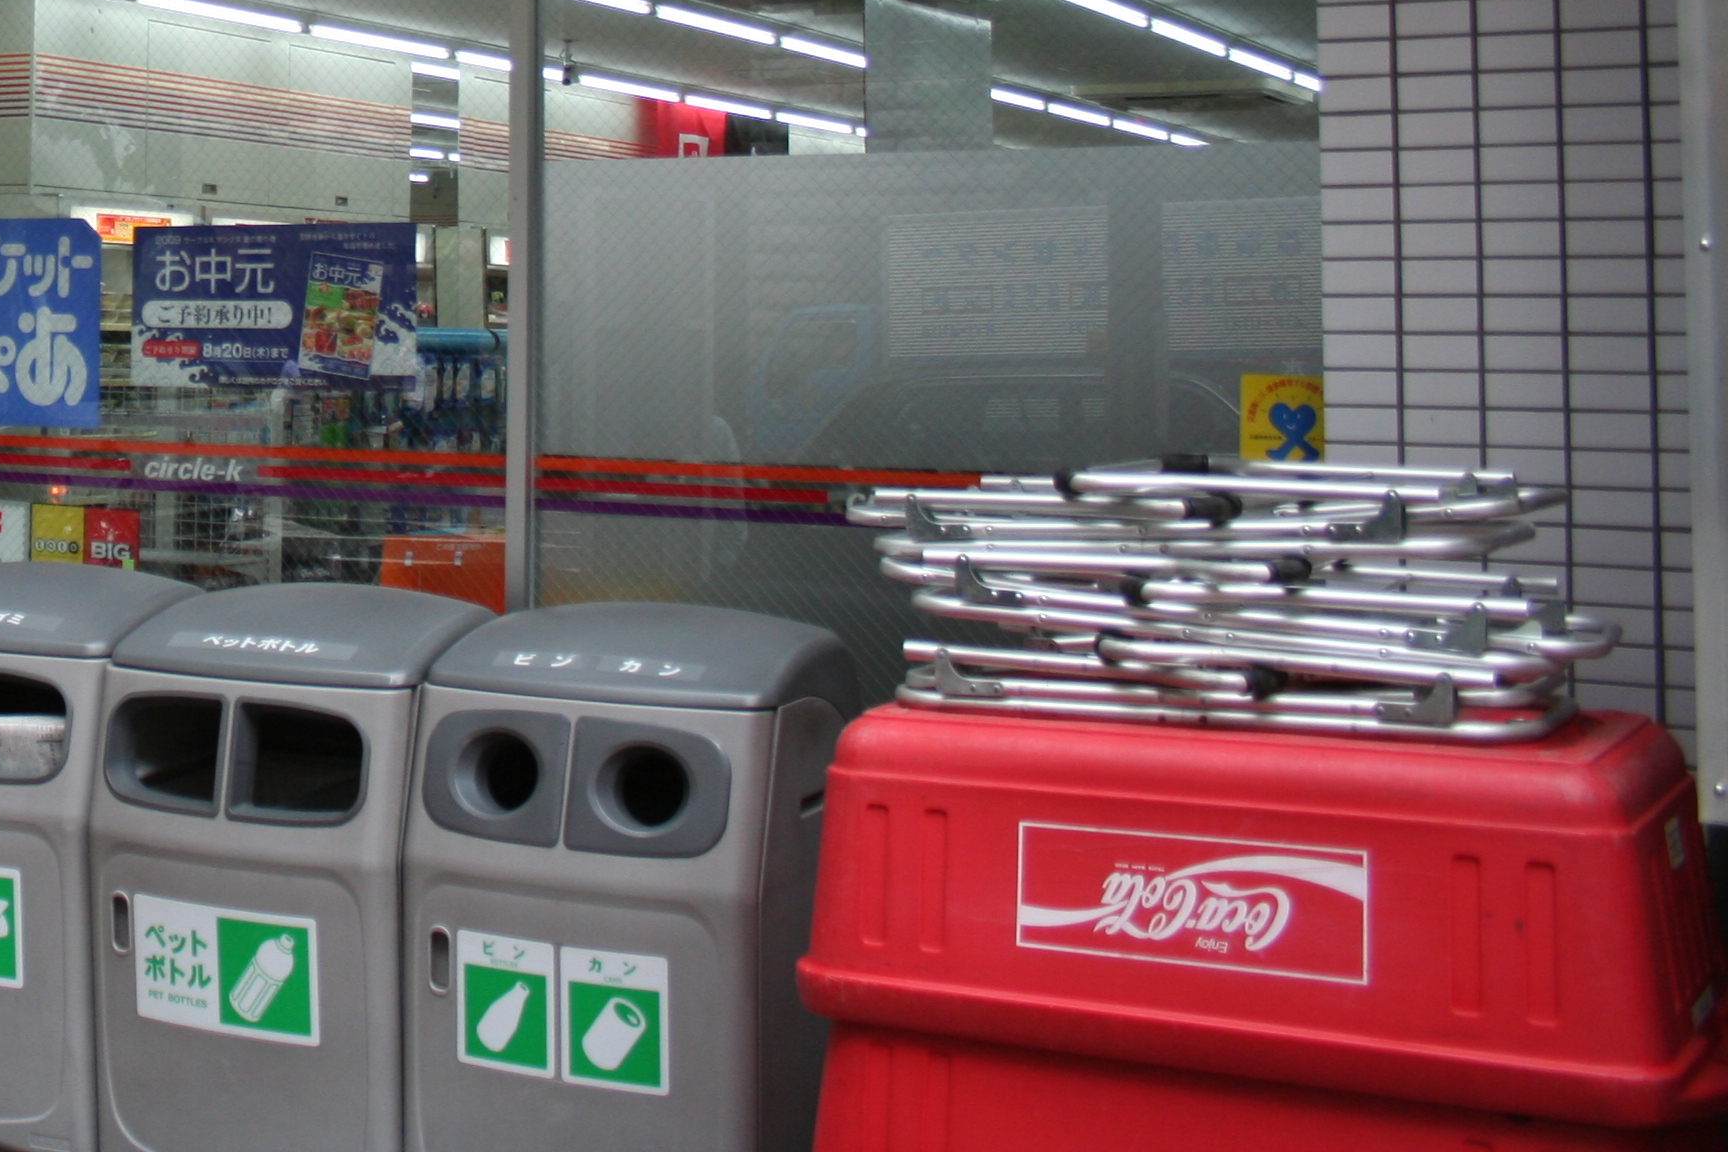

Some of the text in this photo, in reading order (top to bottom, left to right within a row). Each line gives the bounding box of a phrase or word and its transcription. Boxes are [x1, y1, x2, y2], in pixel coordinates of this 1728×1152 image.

[155, 248, 275, 295] お中元
[311, 261, 362, 286] お中元
[144, 458, 243, 482] circle-k
[91, 541, 132, 560] BIG
[202, 634, 320, 655] ペットボトル
[513, 652, 575, 669] ビン
[618, 659, 682, 677] カン
[1094, 873, 1291, 951] Coca-Cola
[144, 924, 209, 958] ペット
[482, 940, 526, 960] ビン
[1194, 936, 1229, 954] Enjoy
[144, 955, 212, 990] ボトル
[588, 956, 638, 976] カン
[147, 988, 209, 1009] PET BOTTLES
